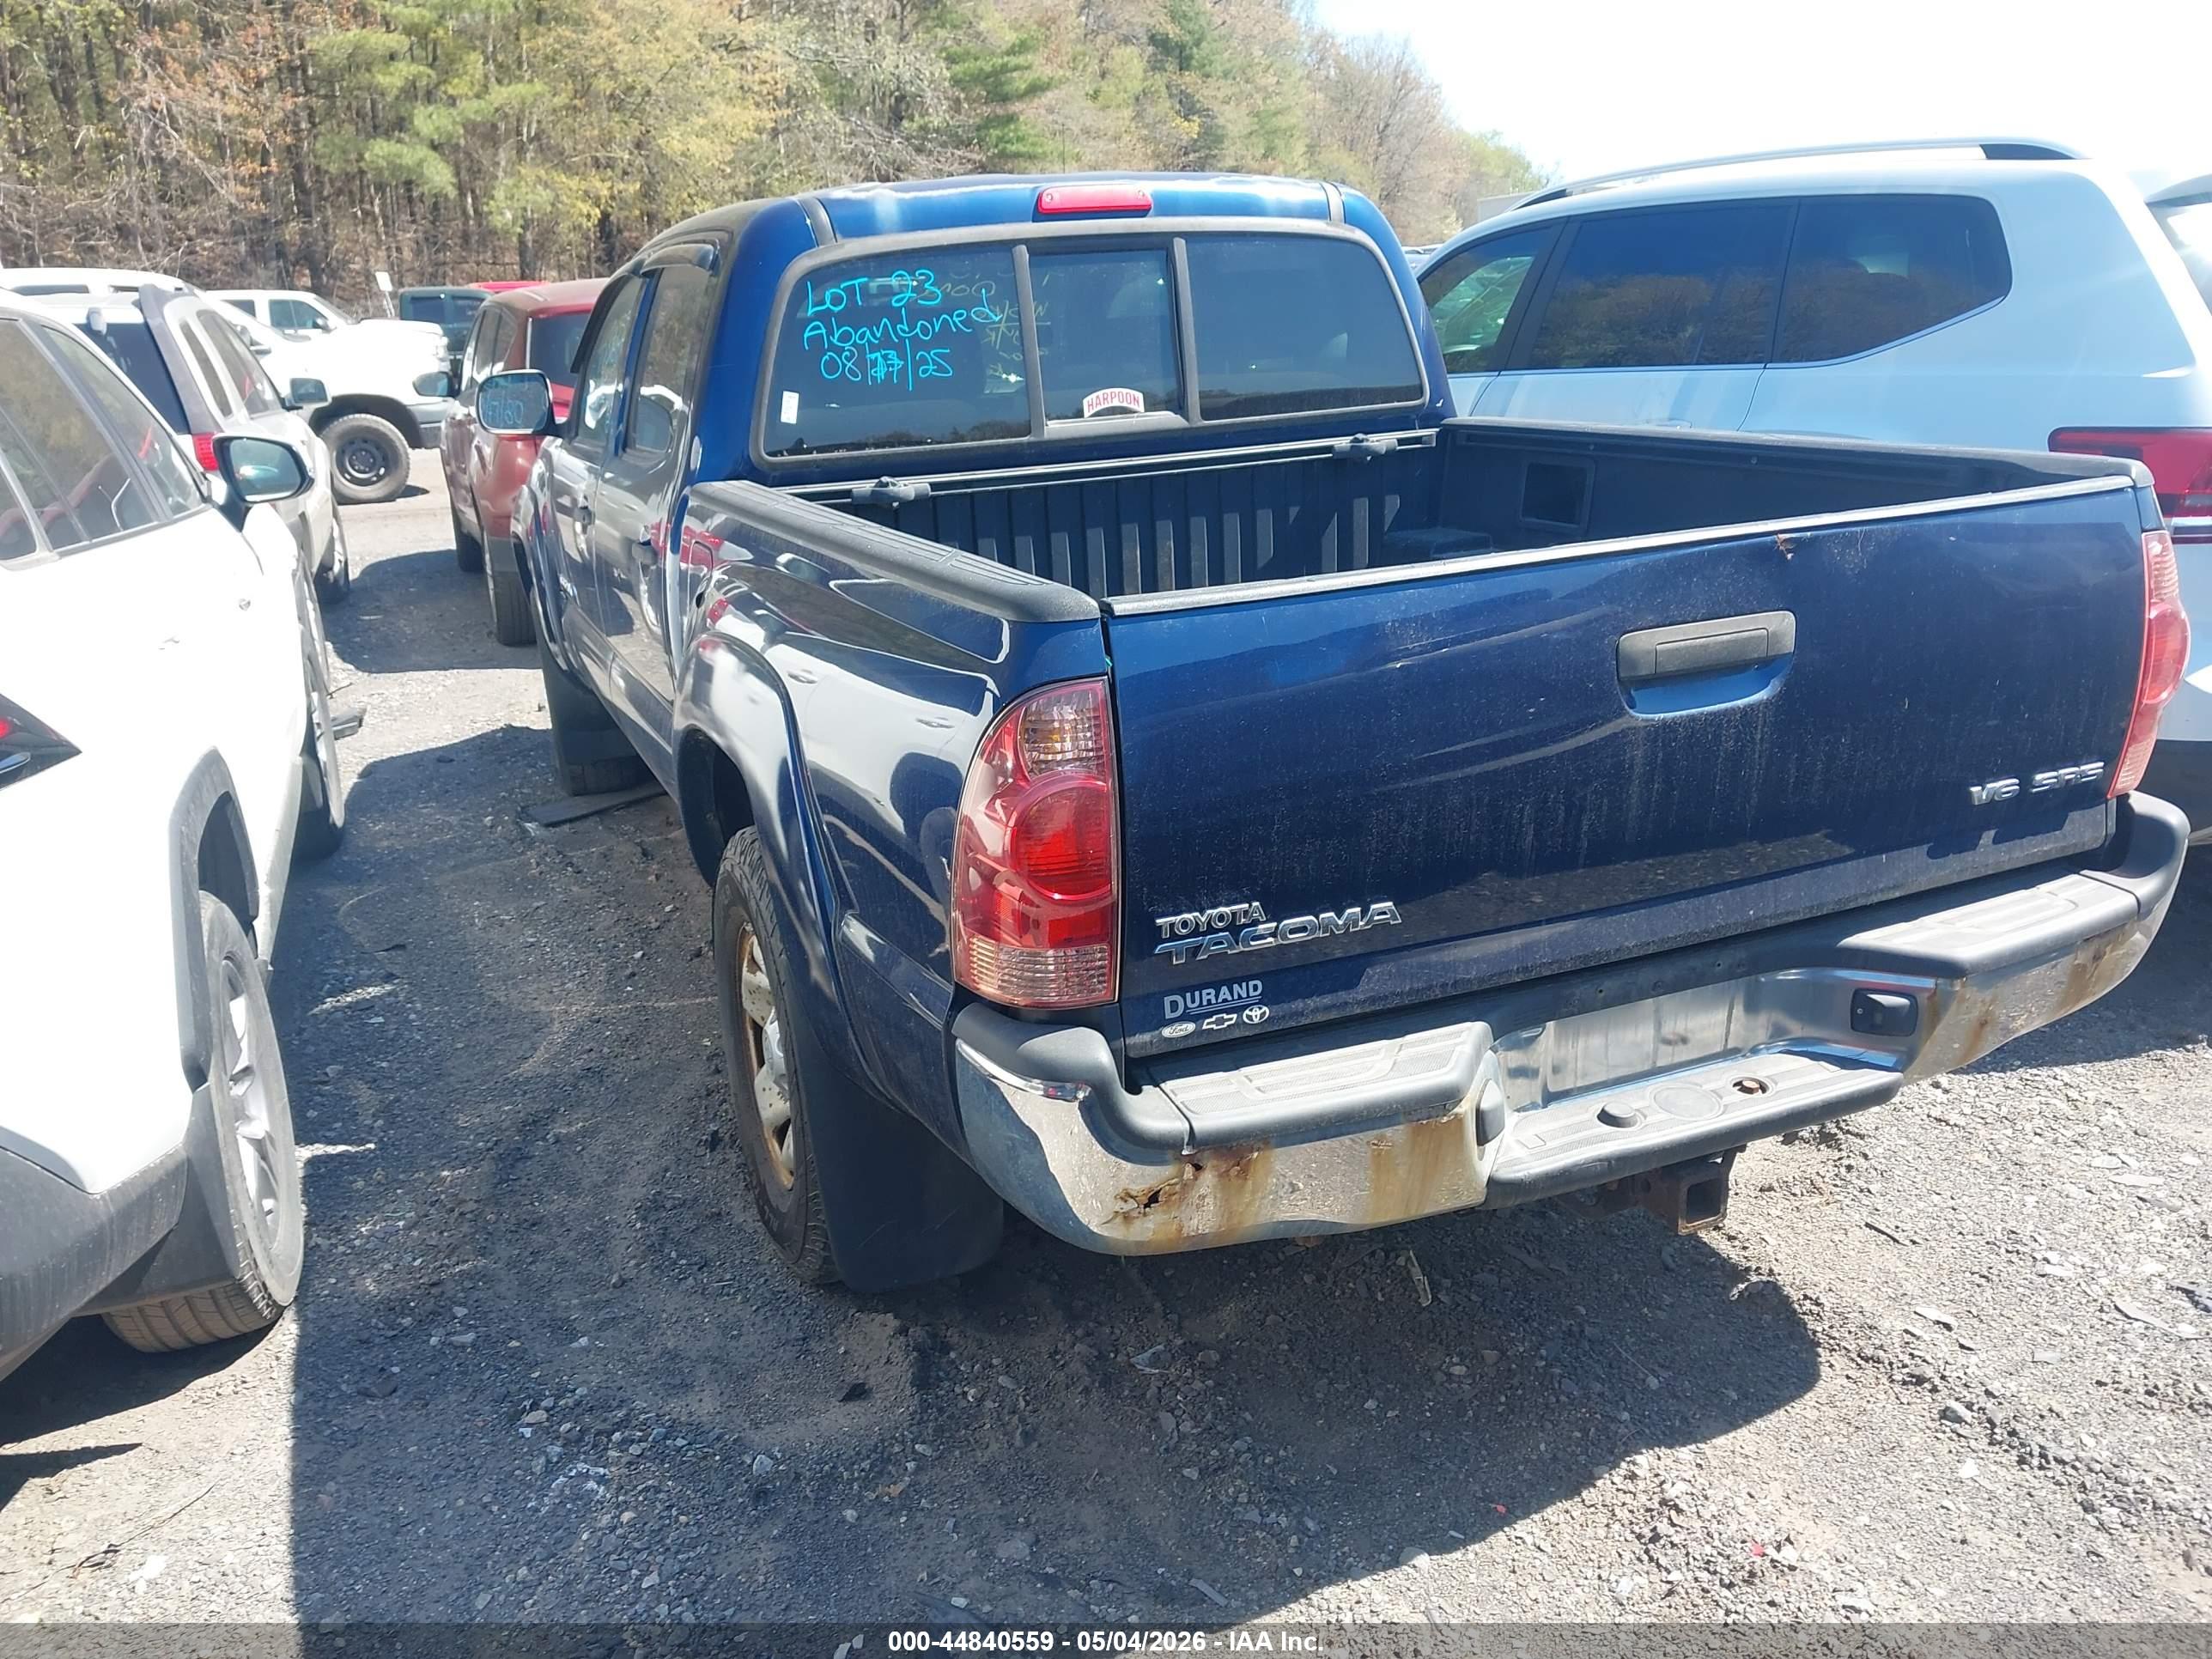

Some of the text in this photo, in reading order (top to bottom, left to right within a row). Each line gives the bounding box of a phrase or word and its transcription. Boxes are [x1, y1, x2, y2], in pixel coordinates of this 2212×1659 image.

[807, 277, 868, 316] LOT
[891, 269, 942, 307] 23
[803, 288, 1003, 350] Abandoned
[1087, 391, 1141, 413] HARPOON
[1969, 778, 2021, 805] V6
[1154, 902, 1402, 965] TACOMA
[1155, 902, 1267, 939] TOYOTA
[1164, 980, 1263, 1019] DURAND
